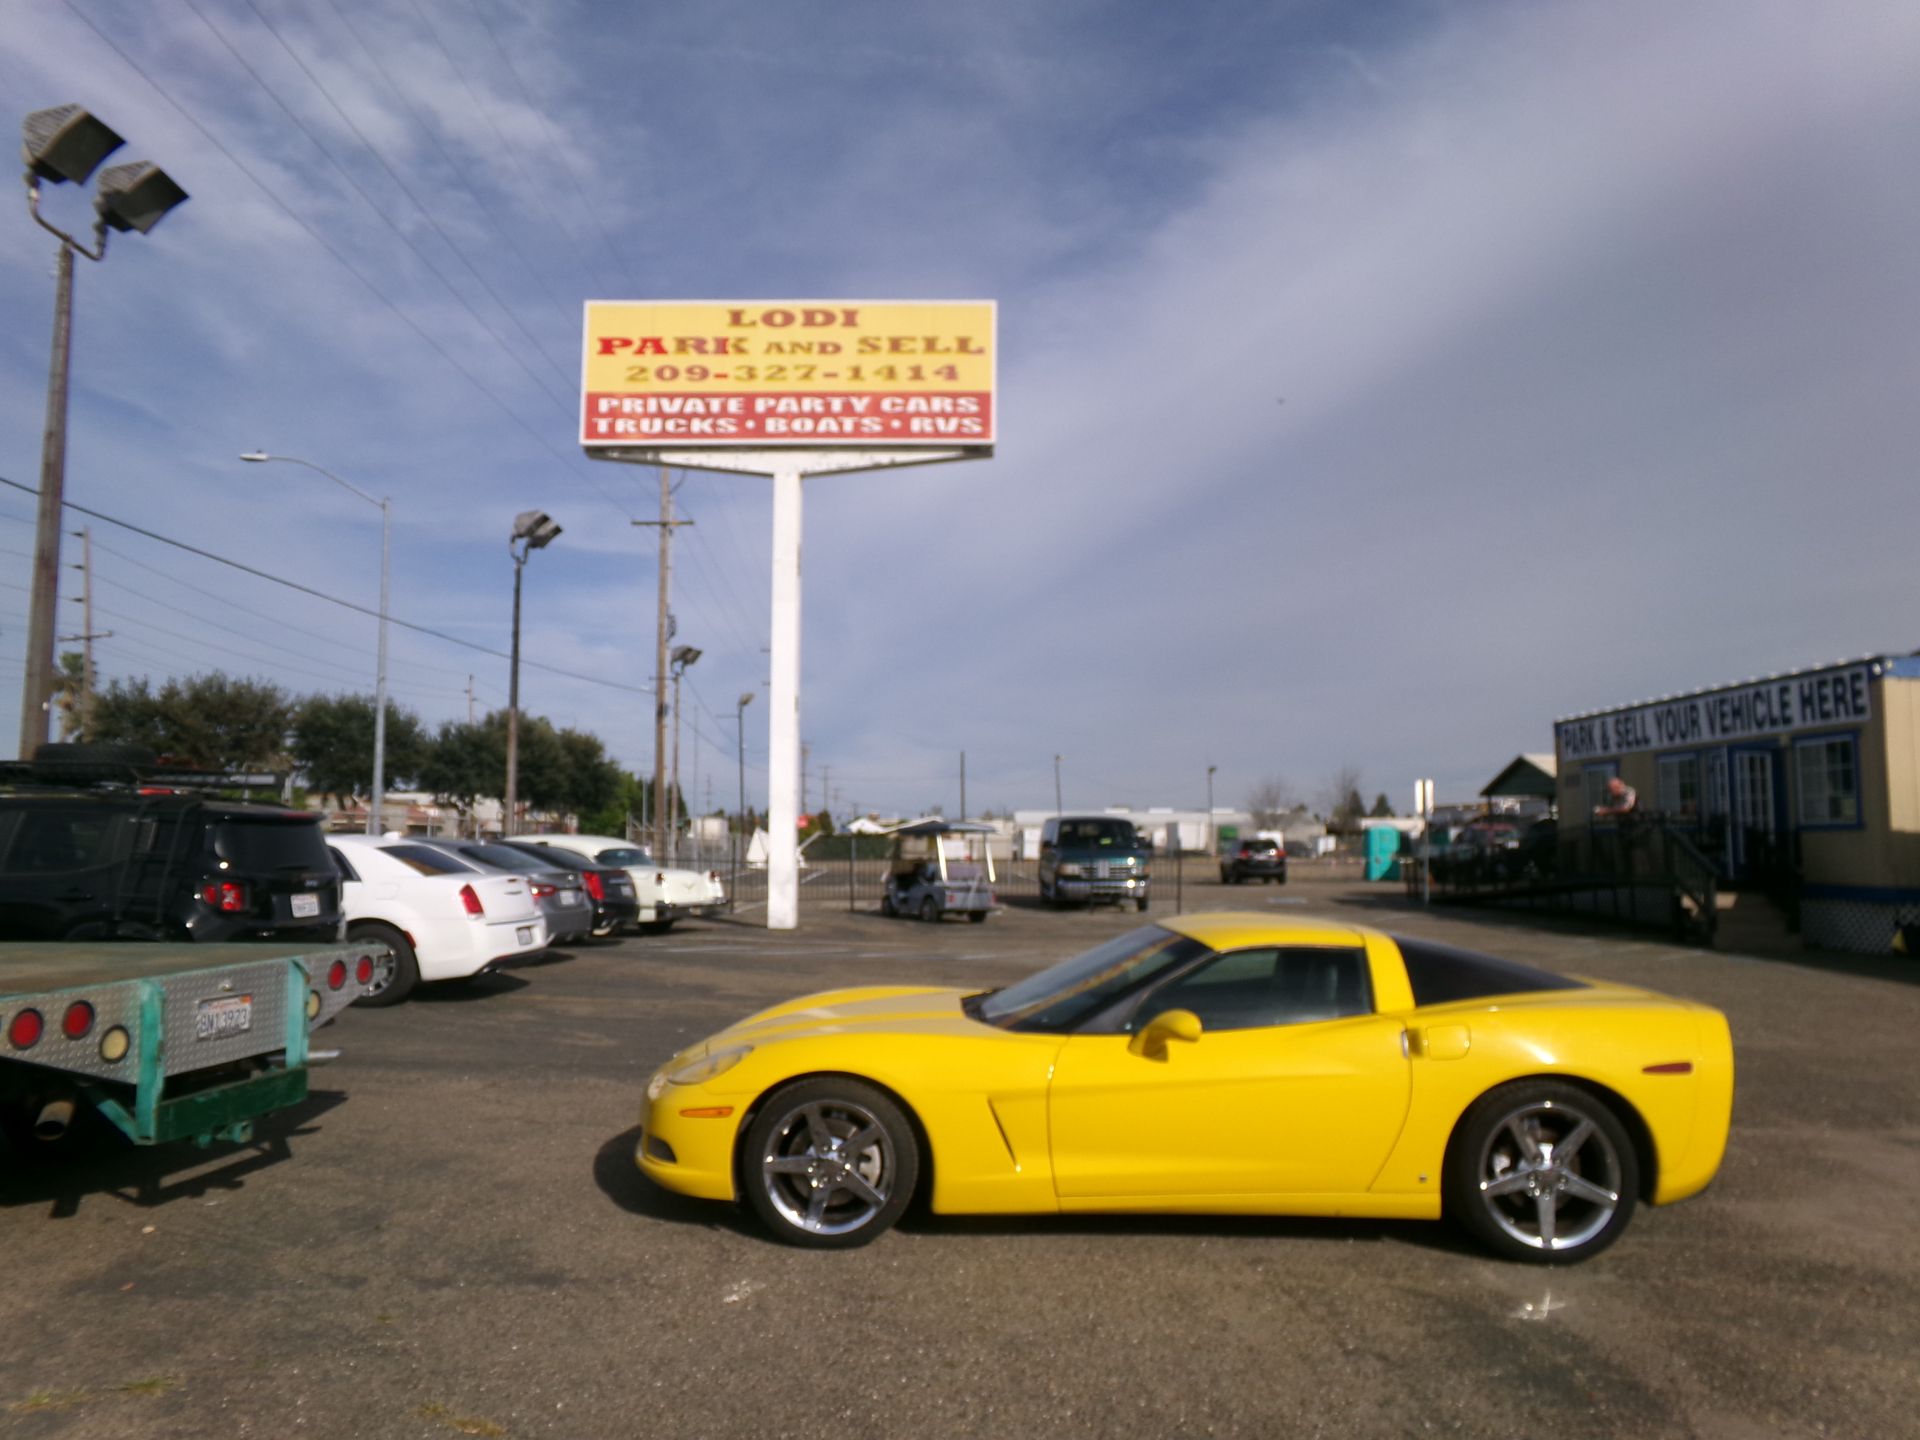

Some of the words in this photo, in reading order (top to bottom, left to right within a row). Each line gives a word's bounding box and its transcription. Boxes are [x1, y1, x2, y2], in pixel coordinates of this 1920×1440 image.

[727, 309, 859, 328] LODI
[597, 336, 750, 355] PARK
[764, 342, 842, 355] AND
[857, 336, 985, 355] SELL
[625, 364, 960, 382] 209-327-1414
[597, 397, 745, 414] PRIVATE
[755, 397, 870, 414] PARTY
[880, 397, 980, 413] CARS
[592, 418, 738, 434] TRUCKS
[765, 418, 884, 433] BOATS
[909, 418, 983, 433] RVS
[1562, 723, 1595, 754] PARK
[1600, 720, 1609, 751] &
[1614, 711, 1651, 747] SELL
[1654, 704, 1702, 742] YOUR
[1705, 684, 1793, 734] VEHICLE
[1800, 672, 1866, 722] HERE
